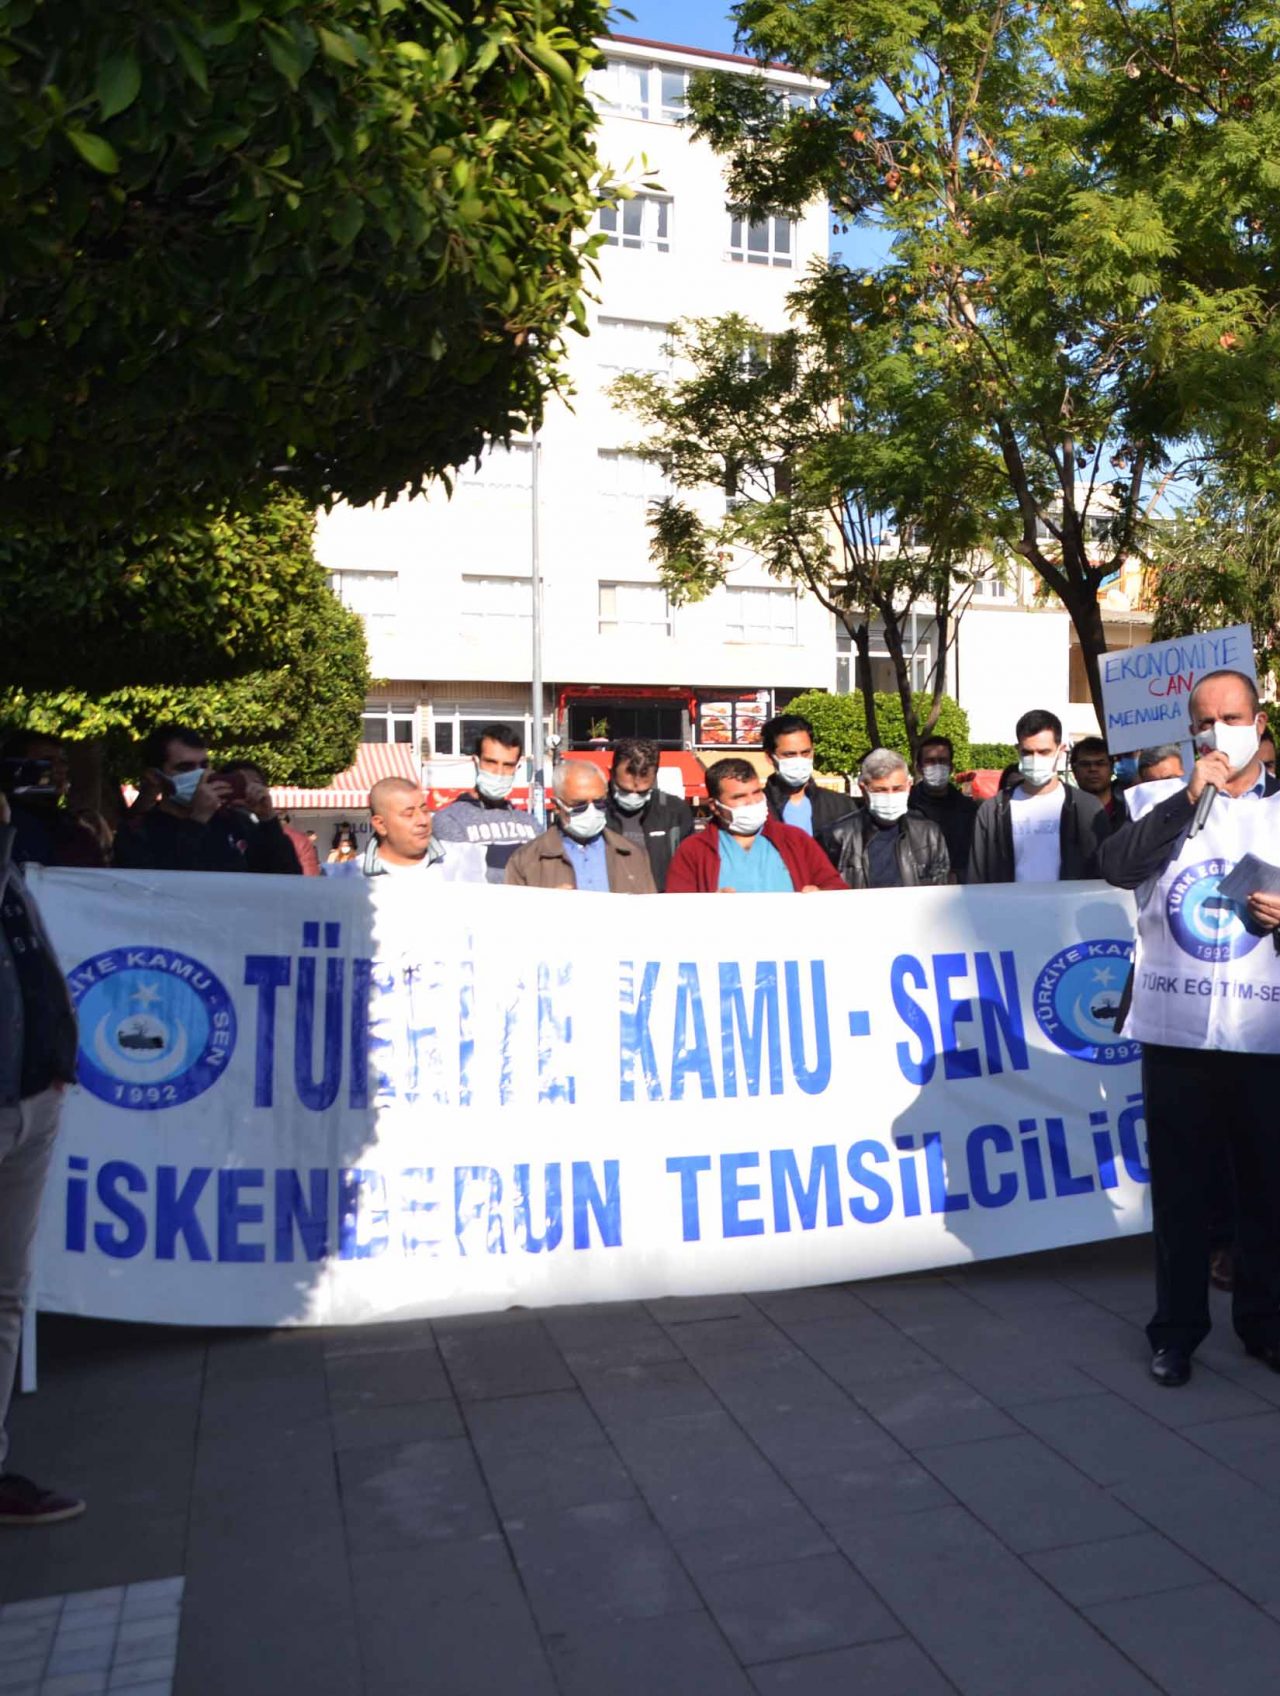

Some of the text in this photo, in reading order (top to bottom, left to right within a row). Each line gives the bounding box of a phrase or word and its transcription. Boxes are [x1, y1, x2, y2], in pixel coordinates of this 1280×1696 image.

[1105, 636, 1240, 683] EKONOMİYE
[1148, 671, 1194, 697] CAN
[1109, 701, 1182, 729] MEMURA
[1142, 973, 1178, 994] TÜRK
[206, 1012, 230, 1066] SEN
[114, 1085, 178, 1103] 1992
